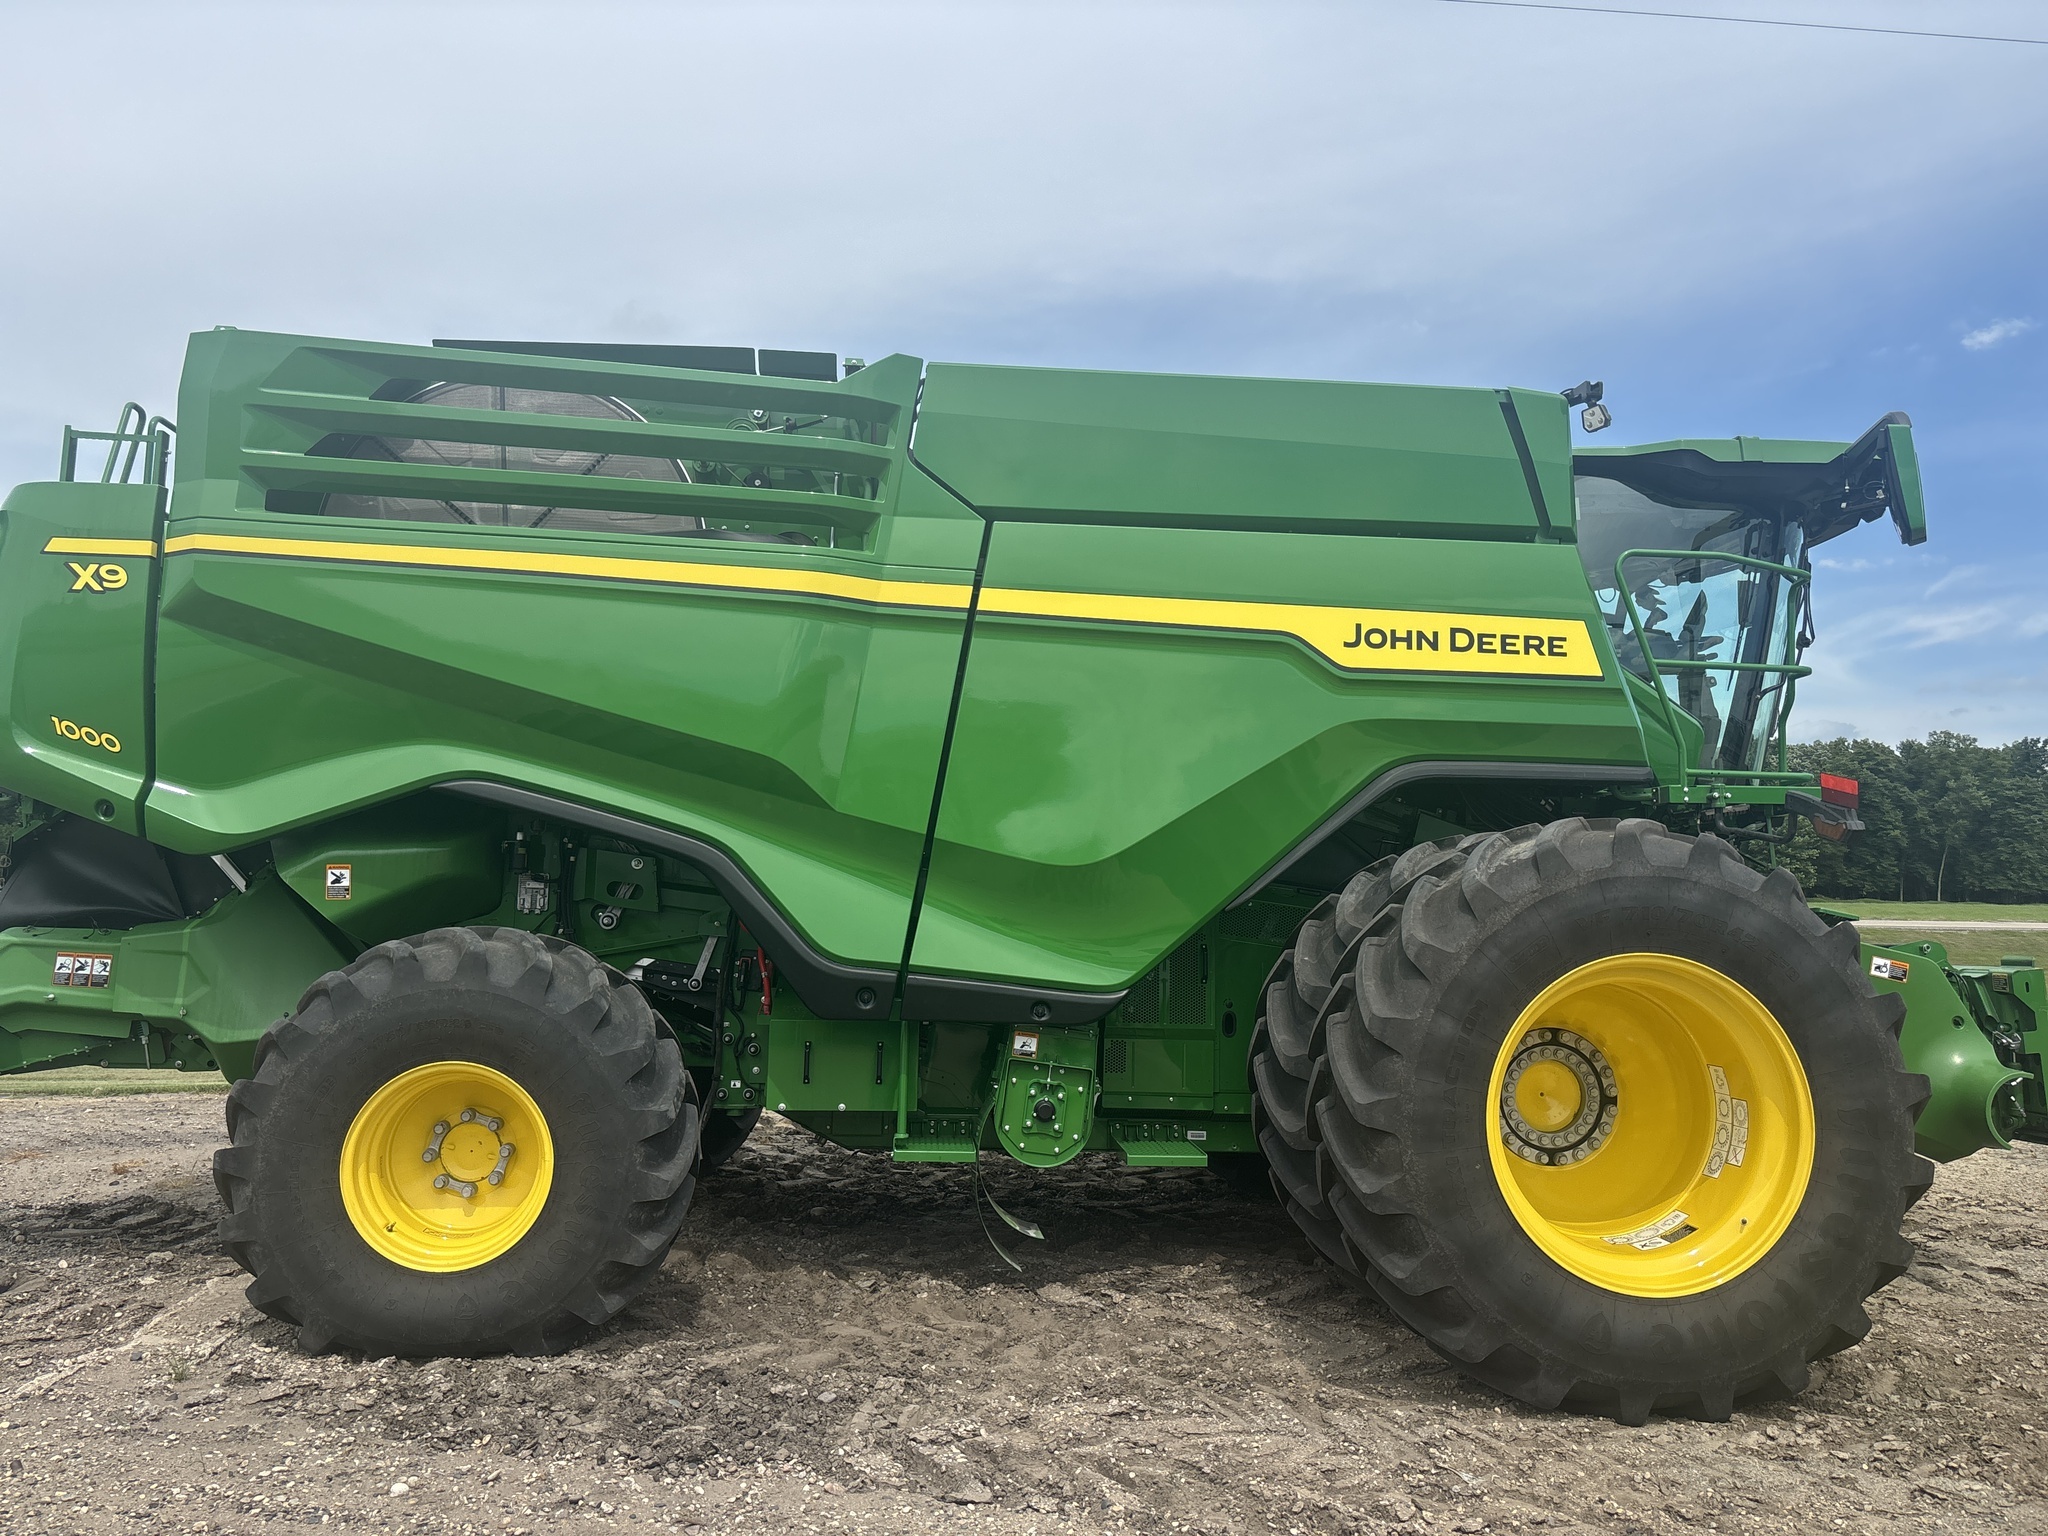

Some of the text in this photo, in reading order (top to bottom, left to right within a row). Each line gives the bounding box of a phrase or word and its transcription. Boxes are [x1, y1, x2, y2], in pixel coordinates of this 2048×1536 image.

[66, 561, 129, 593] X9
[1449, 627, 1568, 658] DEERE
[50, 714, 122, 754] 1000
